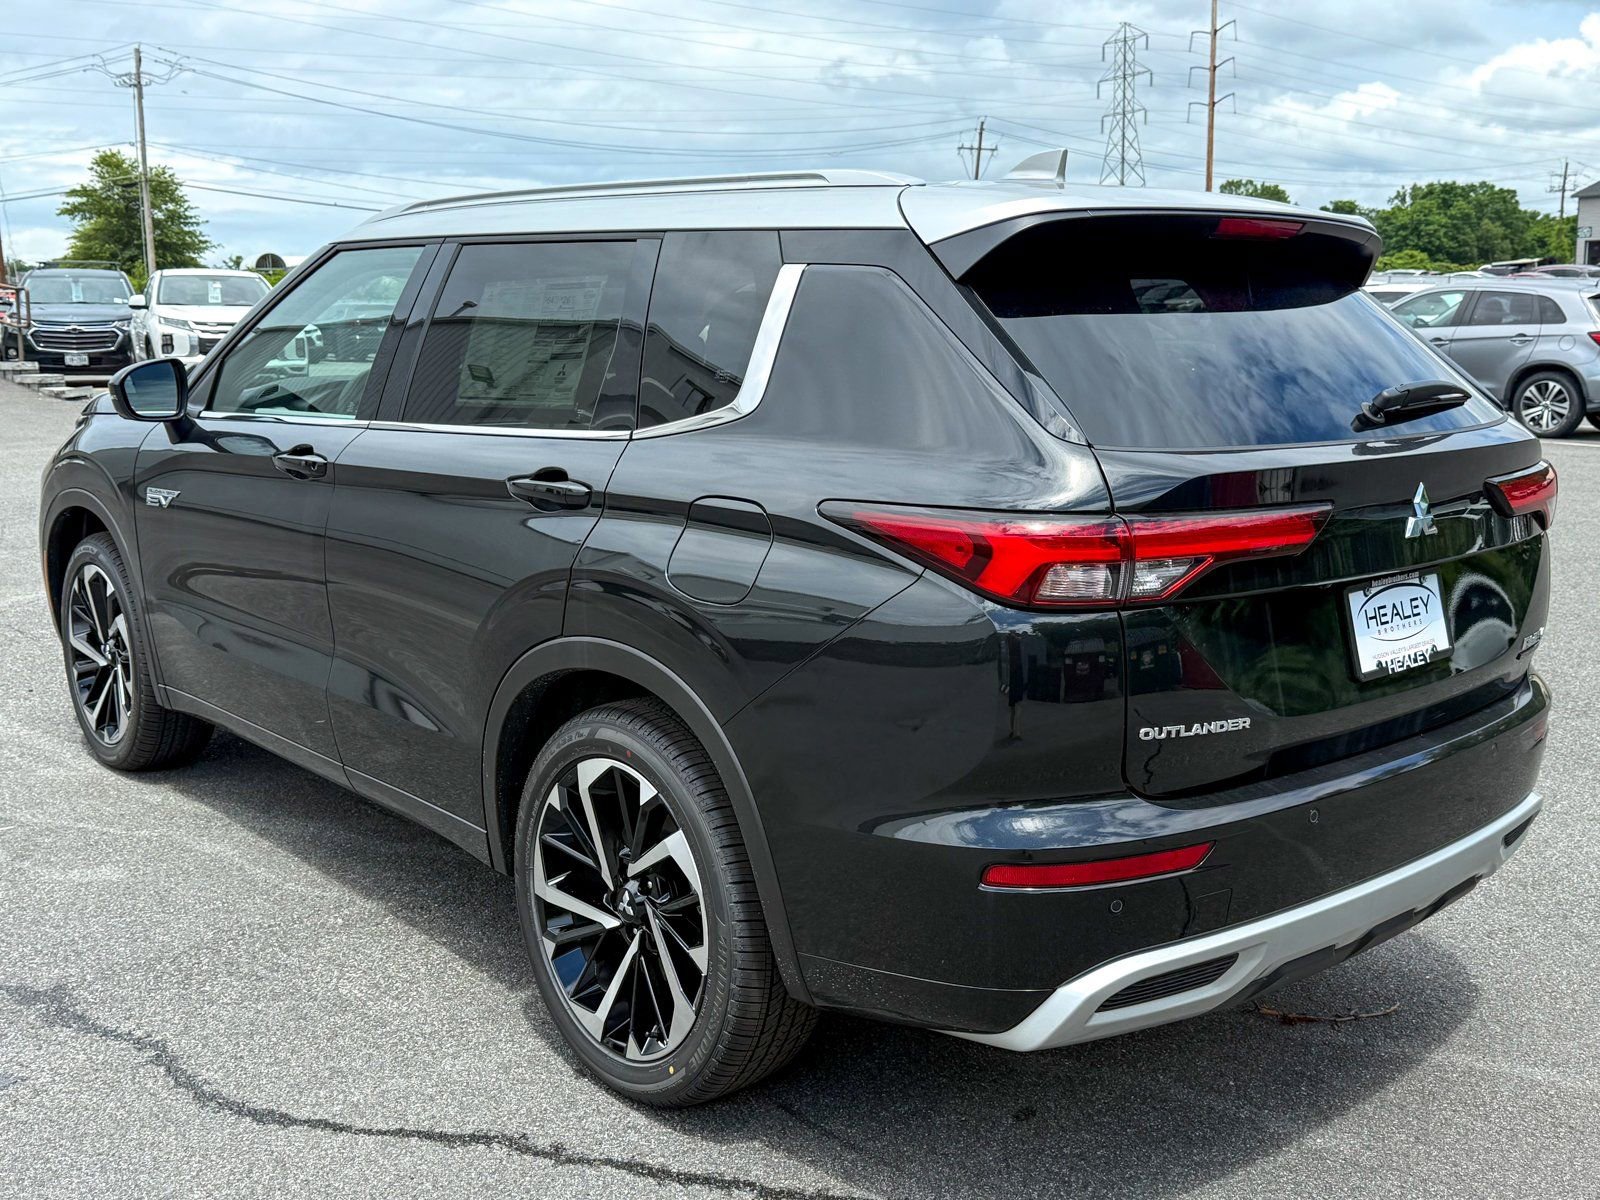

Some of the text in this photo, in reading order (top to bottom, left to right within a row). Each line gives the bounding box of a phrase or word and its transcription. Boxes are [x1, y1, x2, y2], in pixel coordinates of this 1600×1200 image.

[1364, 593, 1431, 630] HEALEY
[1377, 619, 1423, 636] BROTHERS
[1387, 648, 1431, 675] HEALEY
[1138, 717, 1251, 741] OUTLANDER
